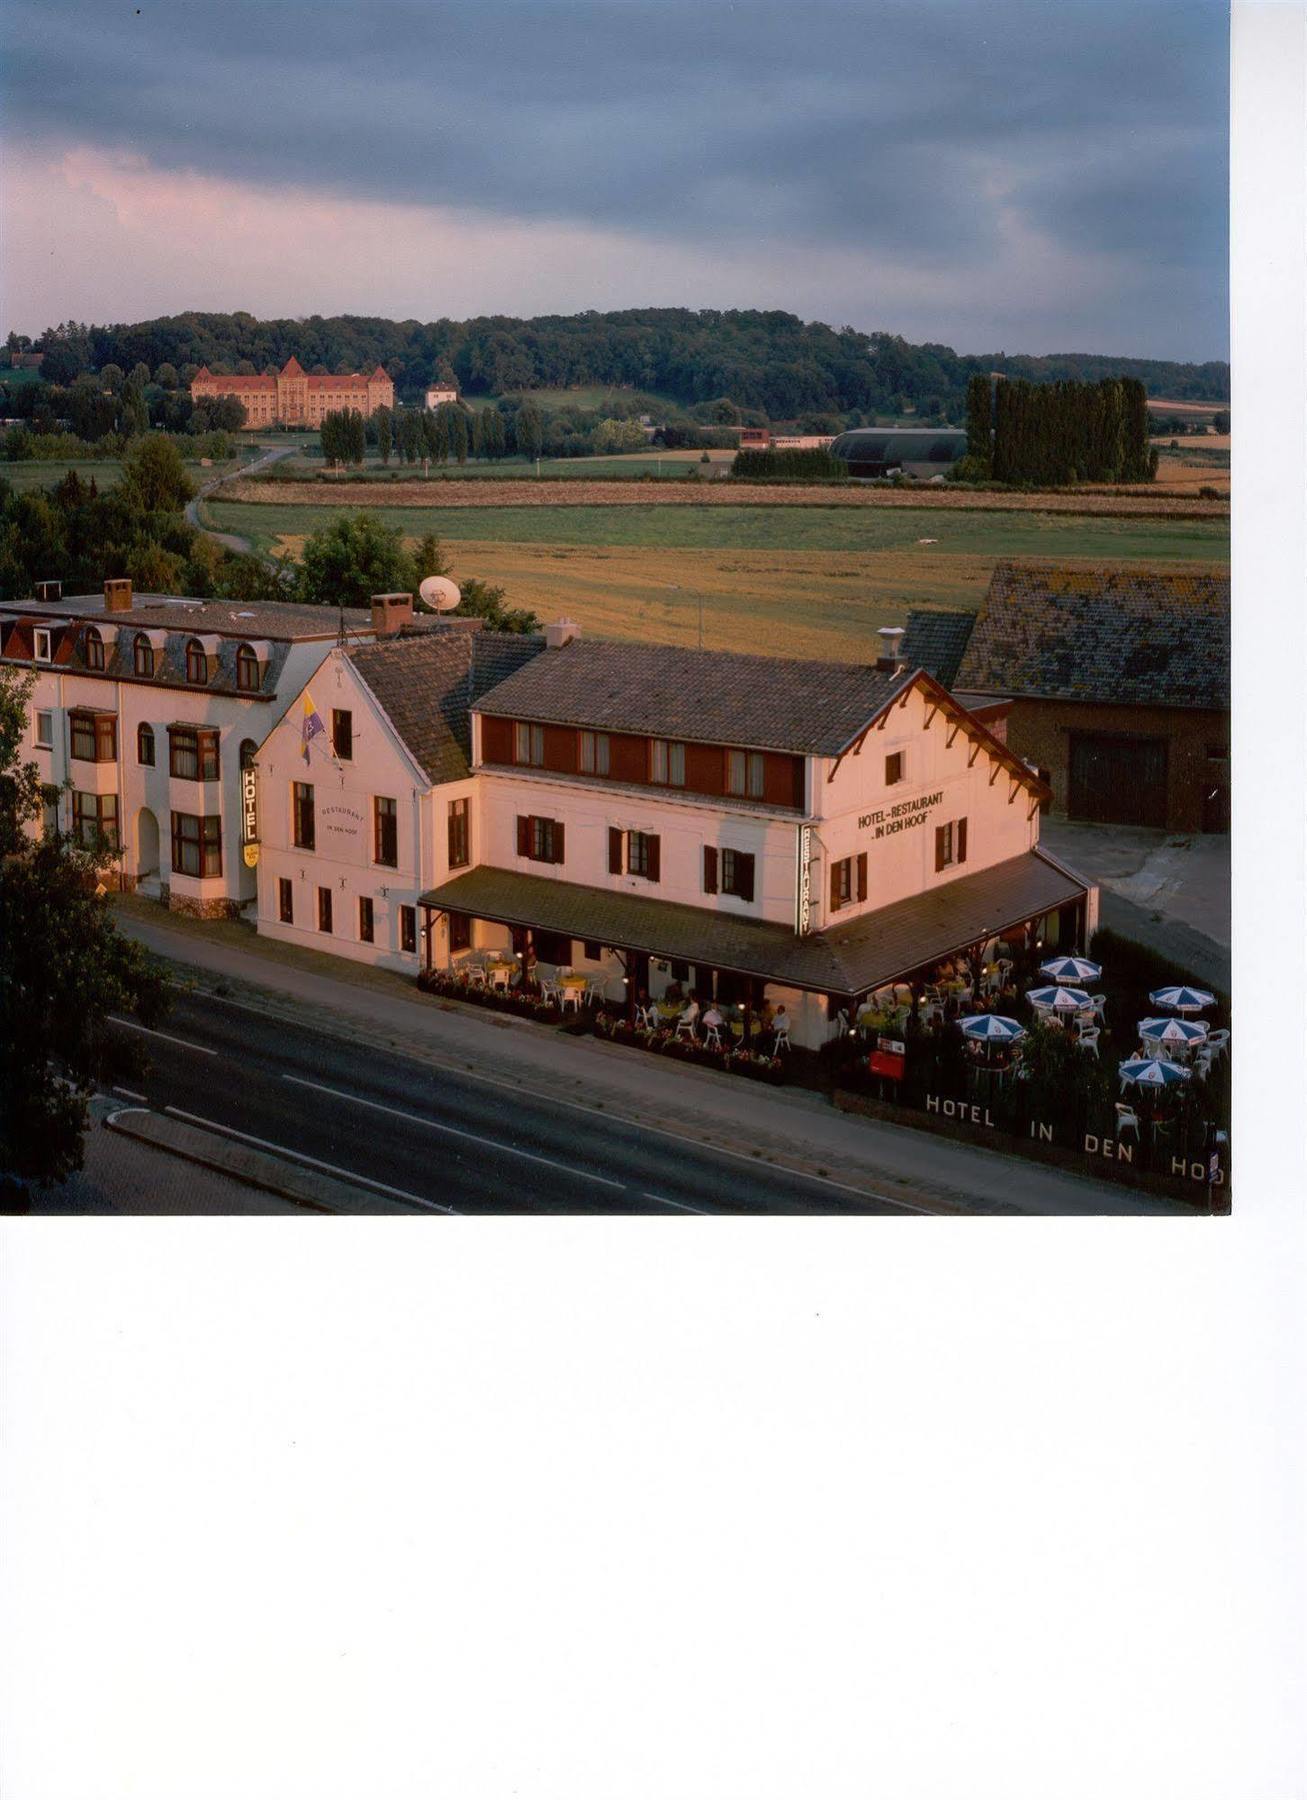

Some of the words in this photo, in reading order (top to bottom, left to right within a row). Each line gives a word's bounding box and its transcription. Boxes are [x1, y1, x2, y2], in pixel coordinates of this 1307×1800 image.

[245, 771, 256, 840] HOTEL
[886, 819, 904, 836] DEN
[803, 827, 811, 932] RESTAURANT
[926, 1094, 995, 1127] HOTEL
[1031, 1120, 1053, 1142] IN
[1085, 1133, 1133, 1162] DEN
